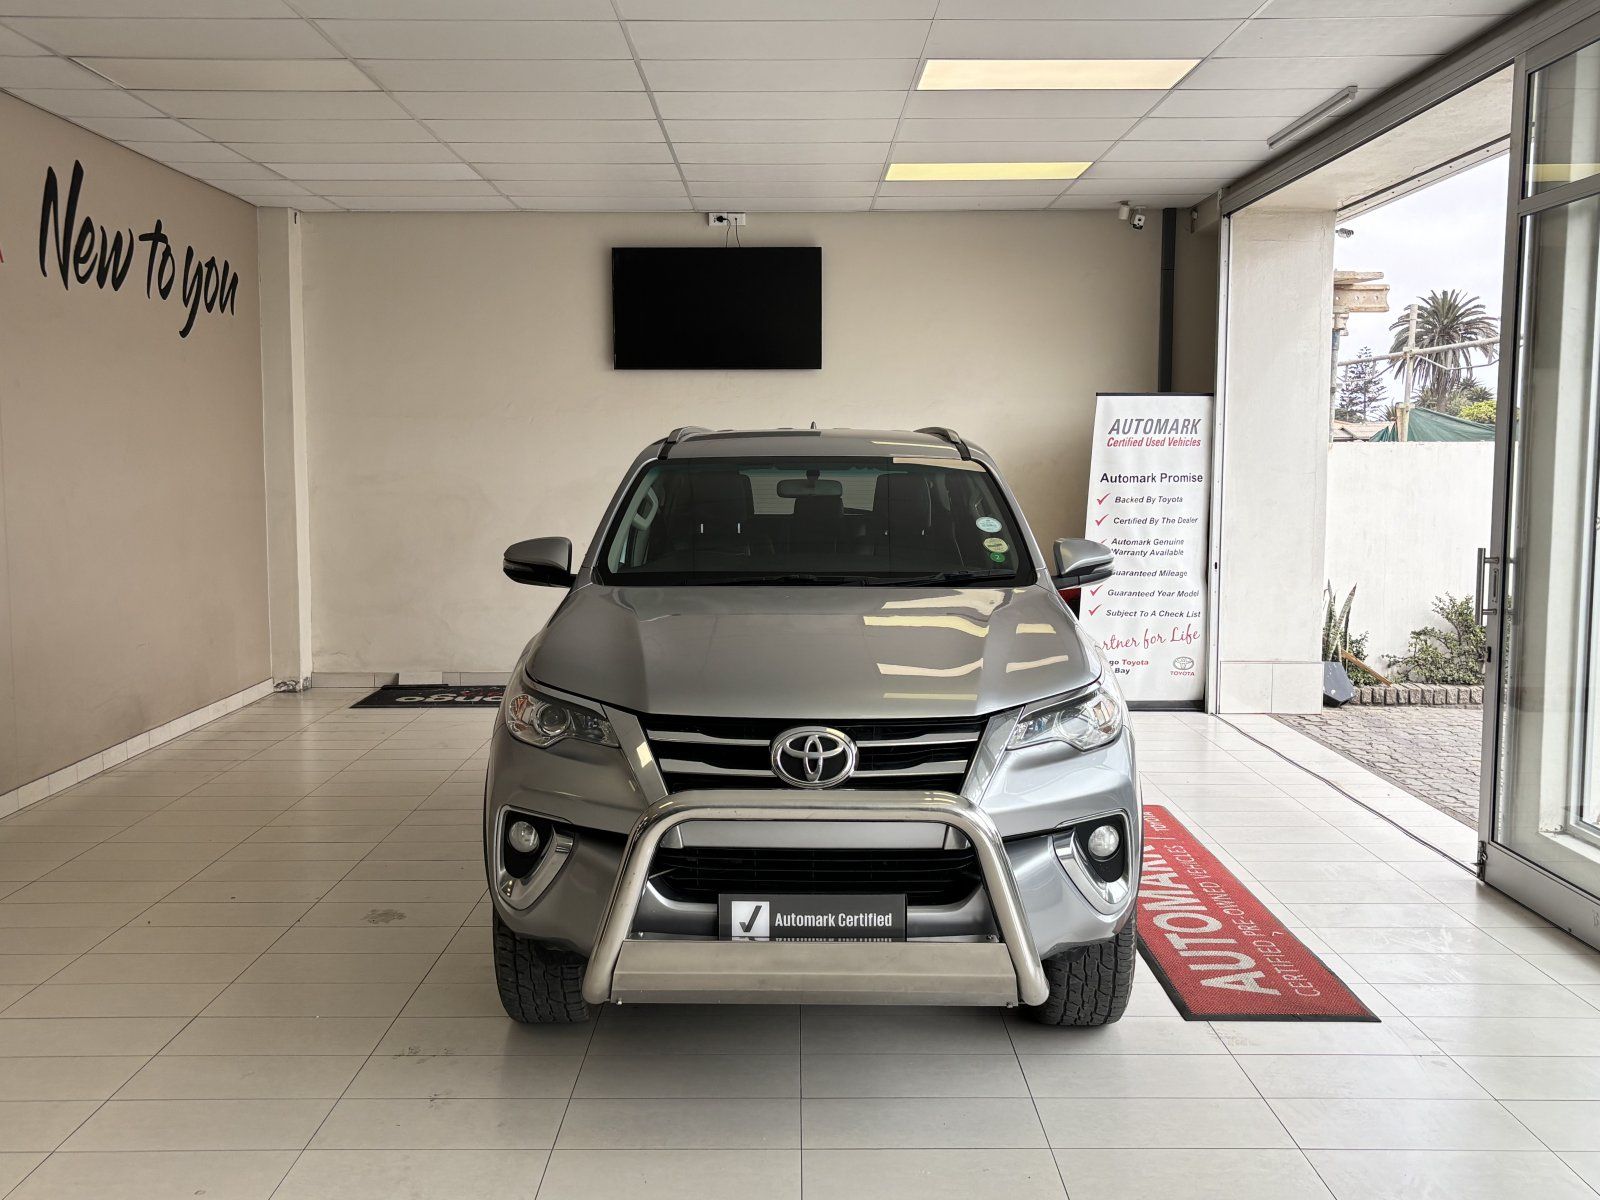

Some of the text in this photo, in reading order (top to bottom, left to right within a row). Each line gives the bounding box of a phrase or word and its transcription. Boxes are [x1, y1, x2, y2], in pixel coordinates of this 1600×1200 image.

[39, 159, 239, 338] New to you
[1107, 418, 1201, 435] AUTOMARK
[1106, 437, 1201, 447] Certified Used Vehicles
[1100, 472, 1203, 483] Automark Promise
[1146, 496, 1156, 504] By
[1158, 496, 1183, 505] Toyota
[1113, 517, 1147, 525] Certified
[1149, 517, 1159, 526] By
[1111, 538, 1184, 546] Automark Genuine
[1111, 548, 1148, 557] Warranty
[1159, 570, 1188, 578] Mileage
[1107, 589, 1155, 597] Guaranteed
[1106, 609, 1137, 618] Subject
[1158, 610, 1184, 618] Check
[1186, 610, 1201, 618] List
[1101, 623, 1200, 650] rtner for Life
[1121, 659, 1149, 667] Toyota
[1114, 667, 1130, 675] Bay
[775, 913, 892, 927] Automark Certified
[1163, 845, 1321, 997] CERTIFIED PRE-OWNED VEHICLES
